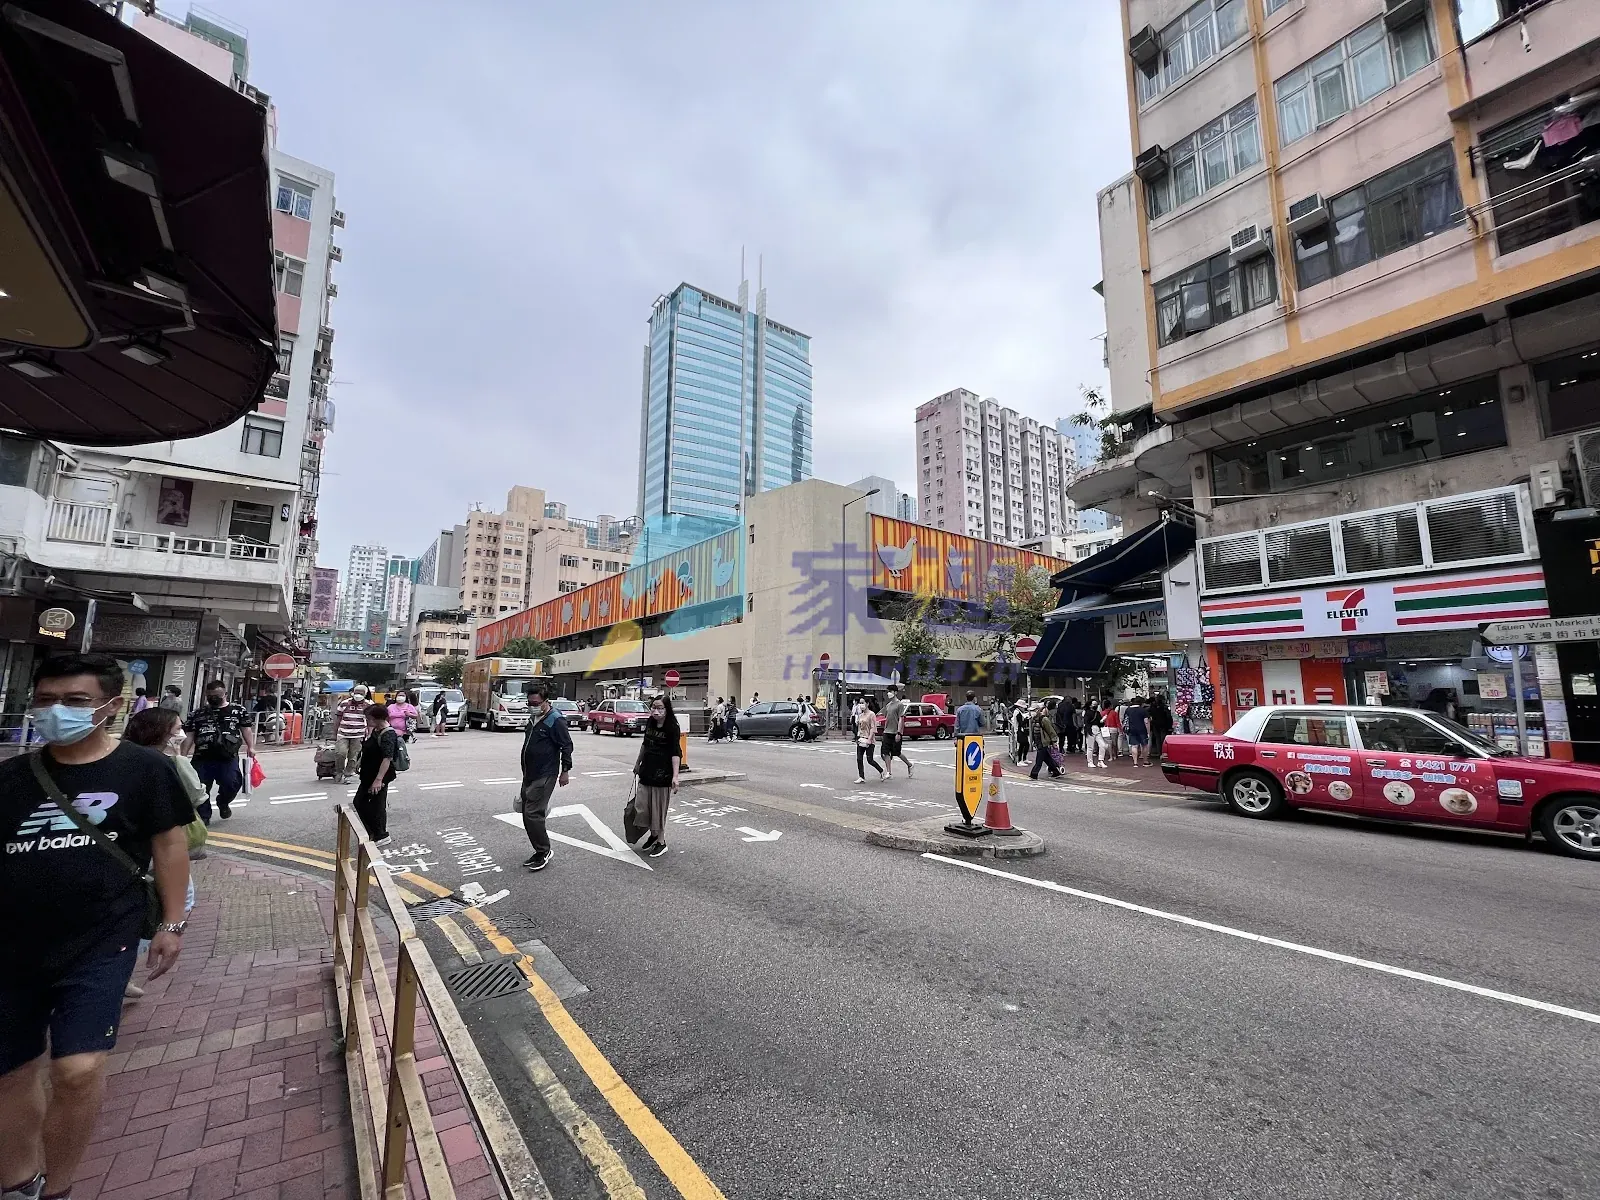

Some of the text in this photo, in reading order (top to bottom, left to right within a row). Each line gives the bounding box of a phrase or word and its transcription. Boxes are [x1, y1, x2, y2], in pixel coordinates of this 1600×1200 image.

[1326, 588, 1365, 631] 7
[1117, 610, 1148, 629] IDEA
[1496, 624, 1525, 632] Tsuen
[1555, 618, 1594, 627] Market
[1213, 742, 1234, 751] 的士
[1214, 750, 1235, 760] TAXI
[1415, 759, 1476, 773] 3421 1771
[436, 827, 503, 877] LOOK RIGHT
